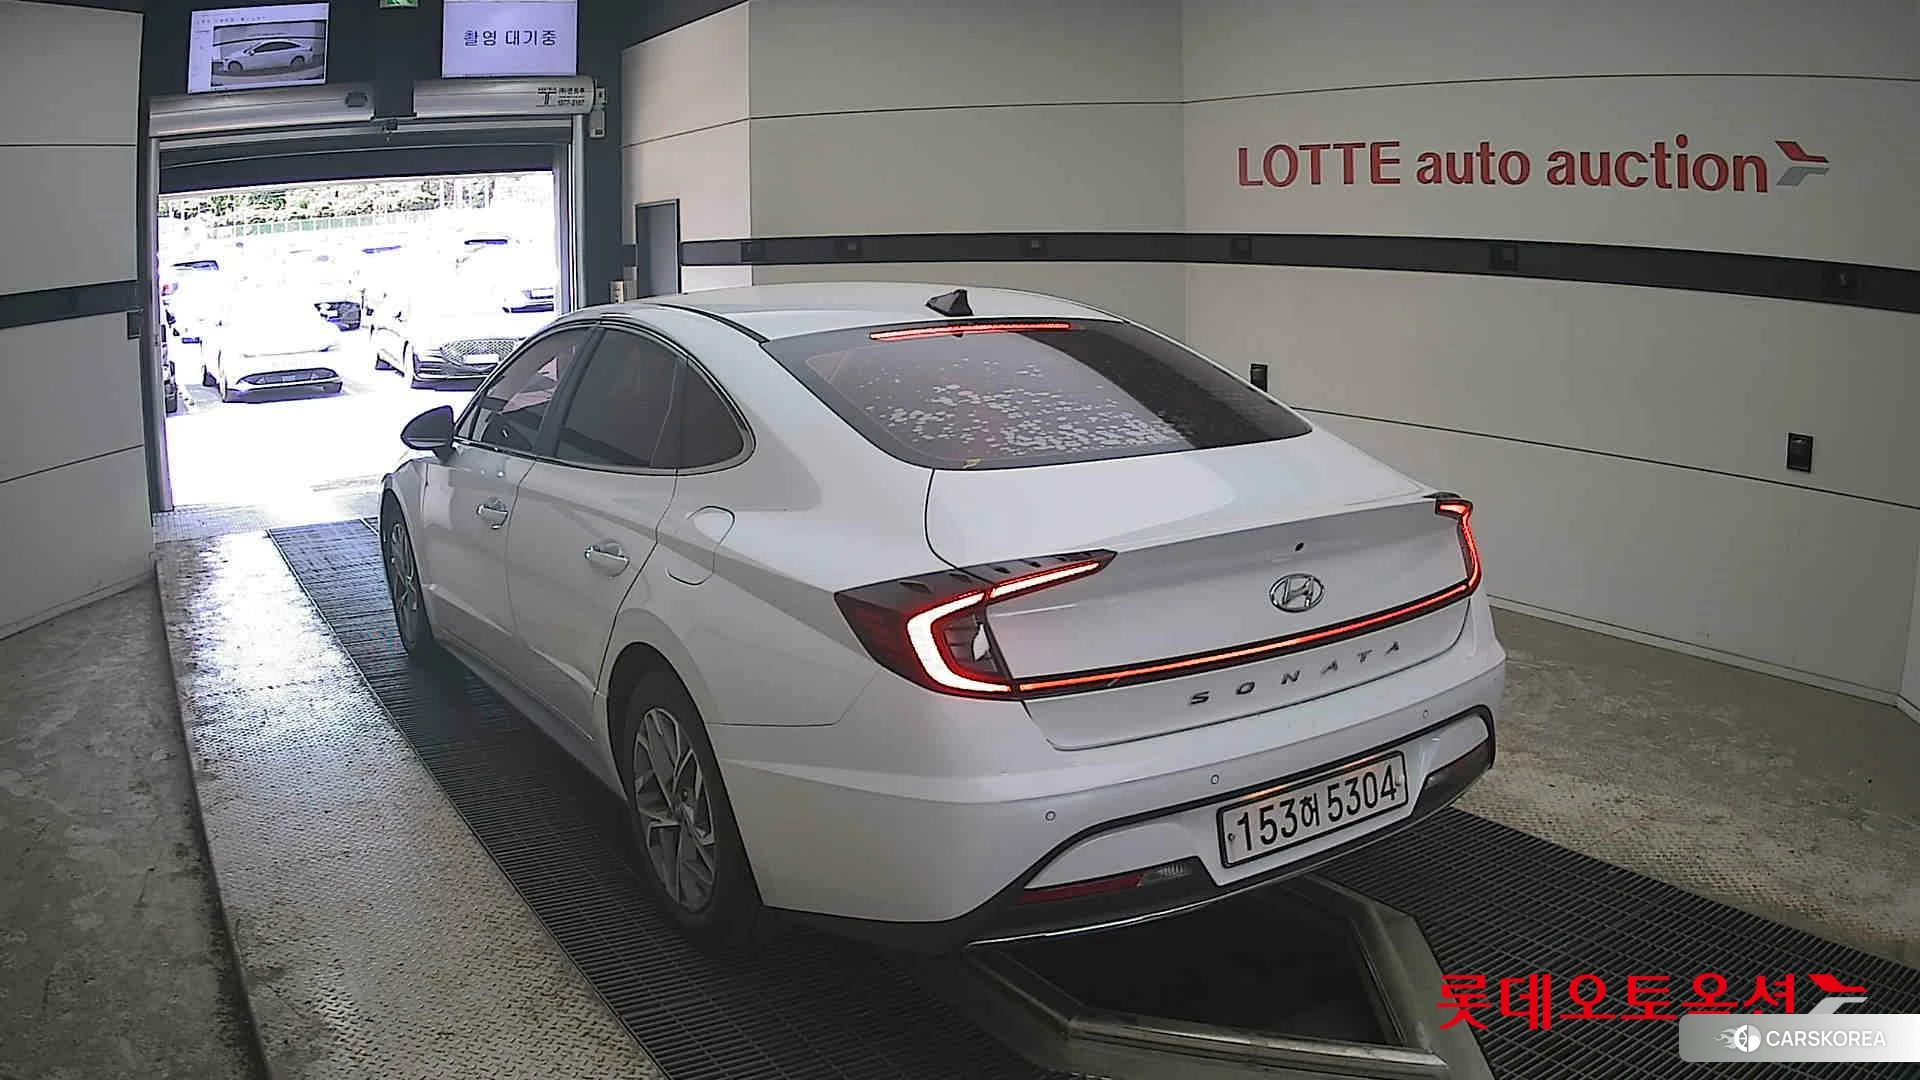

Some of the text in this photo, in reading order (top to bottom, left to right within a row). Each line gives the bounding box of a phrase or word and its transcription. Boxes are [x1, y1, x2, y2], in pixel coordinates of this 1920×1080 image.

[505, 30, 557, 46] 대기중
[1238, 134, 1768, 193] LOTTE auto auction
[1190, 642, 1400, 704] SONATA
